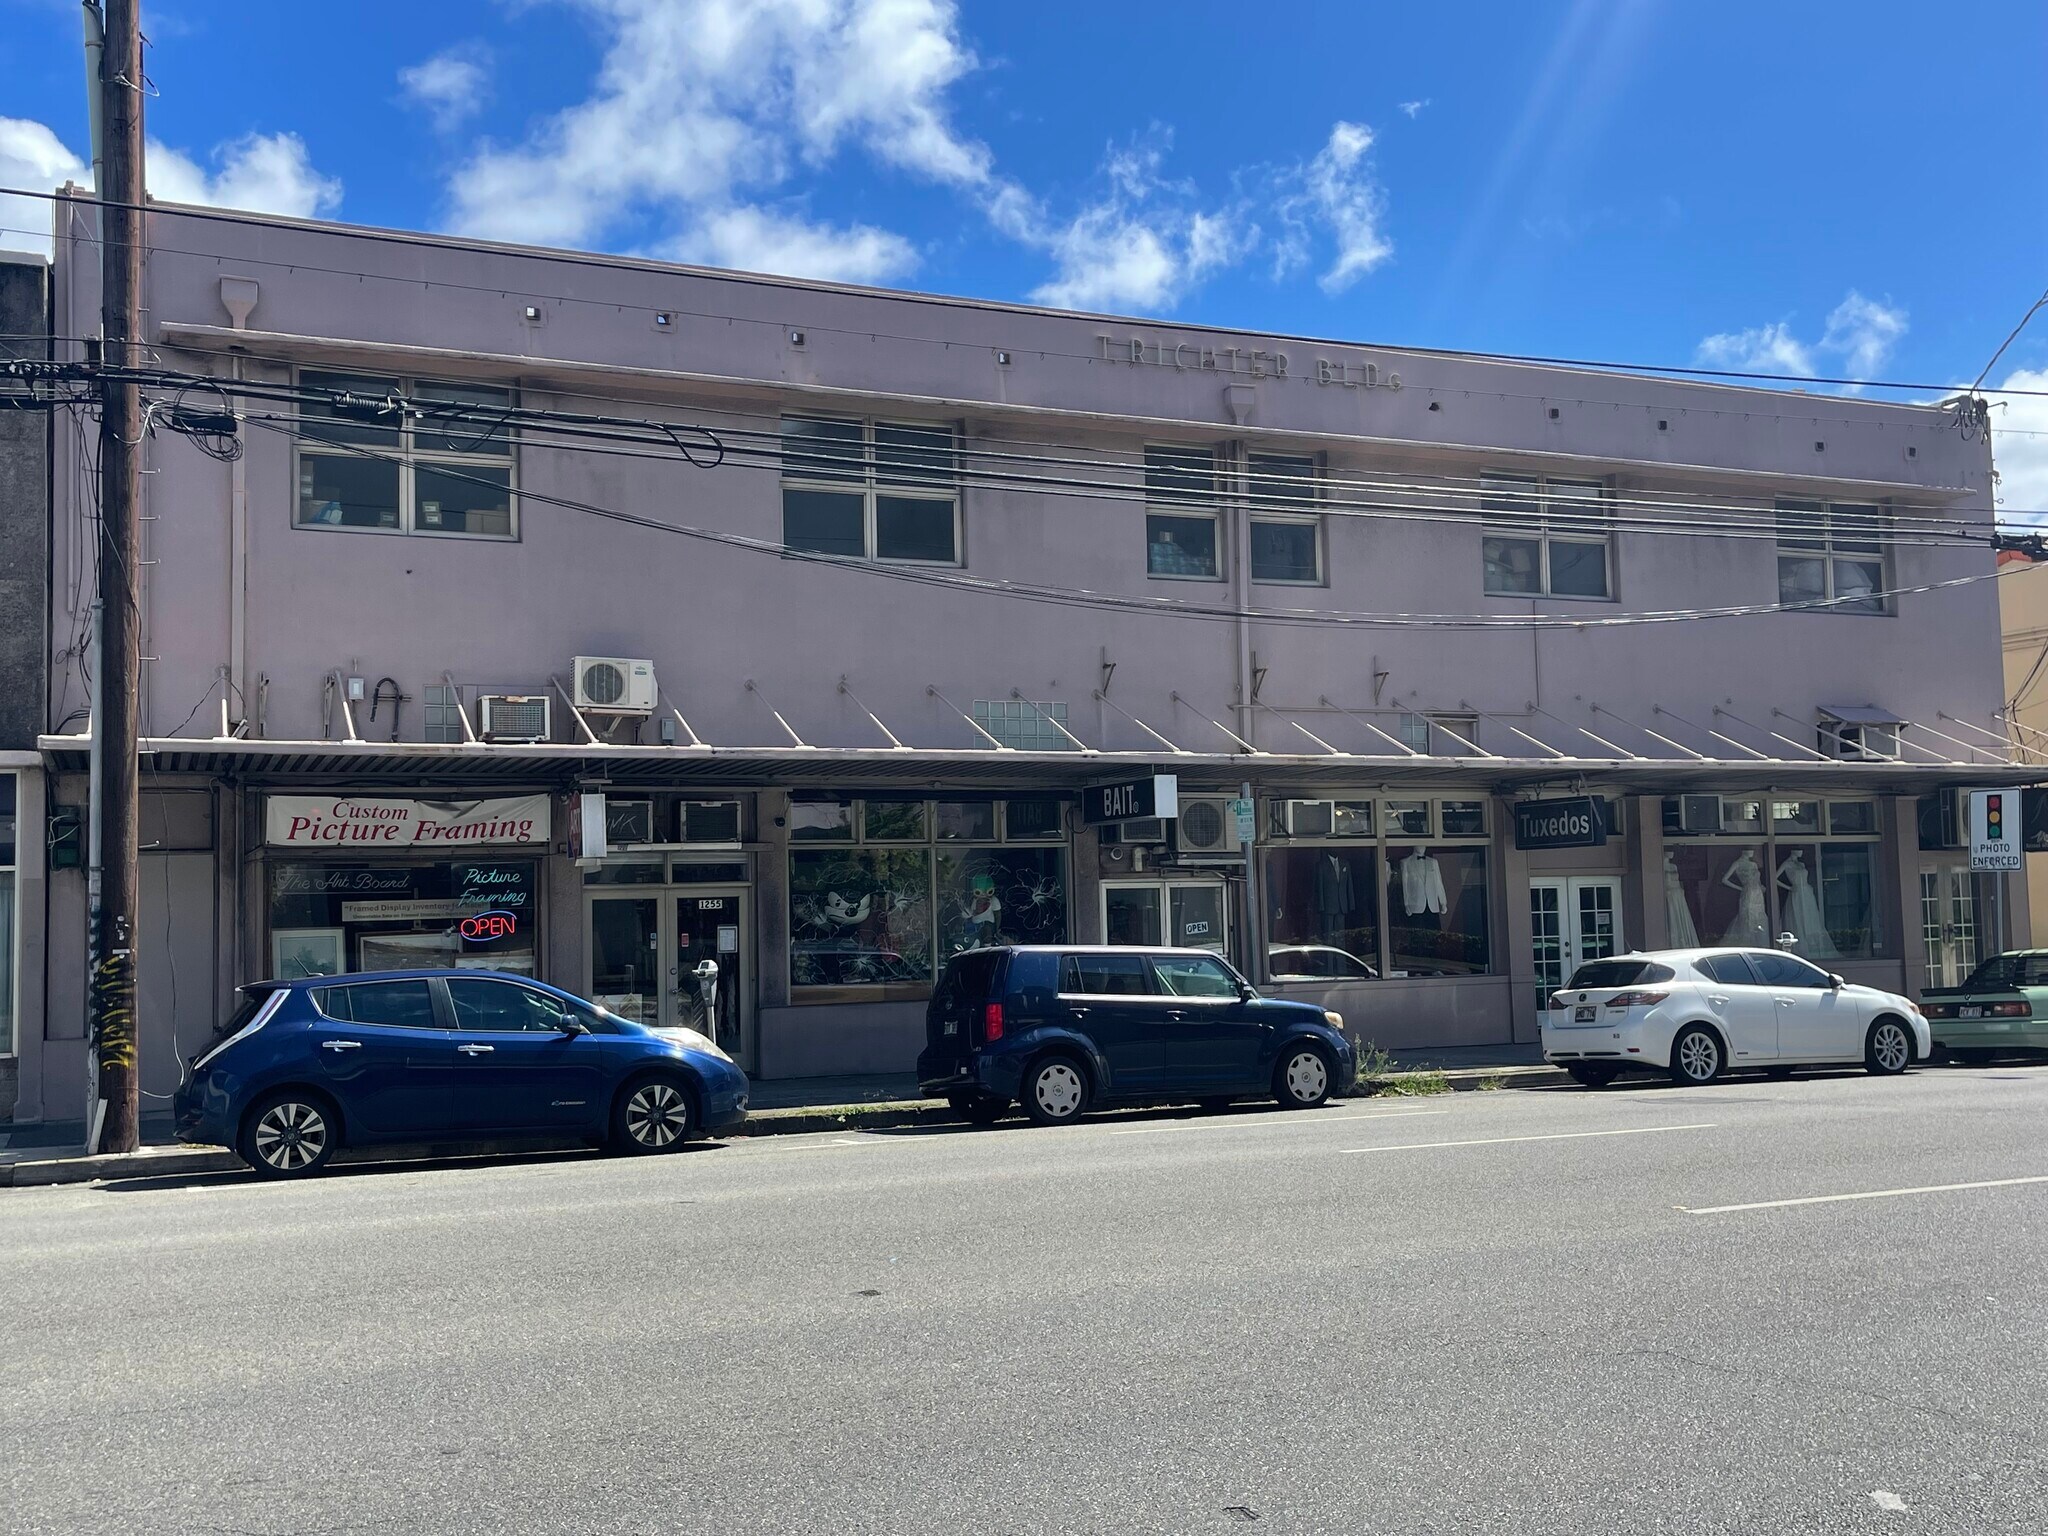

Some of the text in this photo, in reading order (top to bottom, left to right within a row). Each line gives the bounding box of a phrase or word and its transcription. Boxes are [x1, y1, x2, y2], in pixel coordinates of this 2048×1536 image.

[1097, 335, 1290, 379] TRICHTER
[332, 801, 409, 821] Custom
[1103, 785, 1136, 817] BAIT
[286, 815, 533, 843] Picture Framing
[1520, 810, 1591, 838] Tuxedos
[1980, 843, 2010, 853] PHOTO
[1972, 856, 2019, 866] ENFORCED
[278, 871, 409, 890] The Art Board
[461, 868, 523, 885] Picture
[457, 888, 527, 908] Framing
[699, 900, 722, 909] 1255
[460, 916, 517, 936] OPEN
[1187, 922, 1208, 933] OPEN
